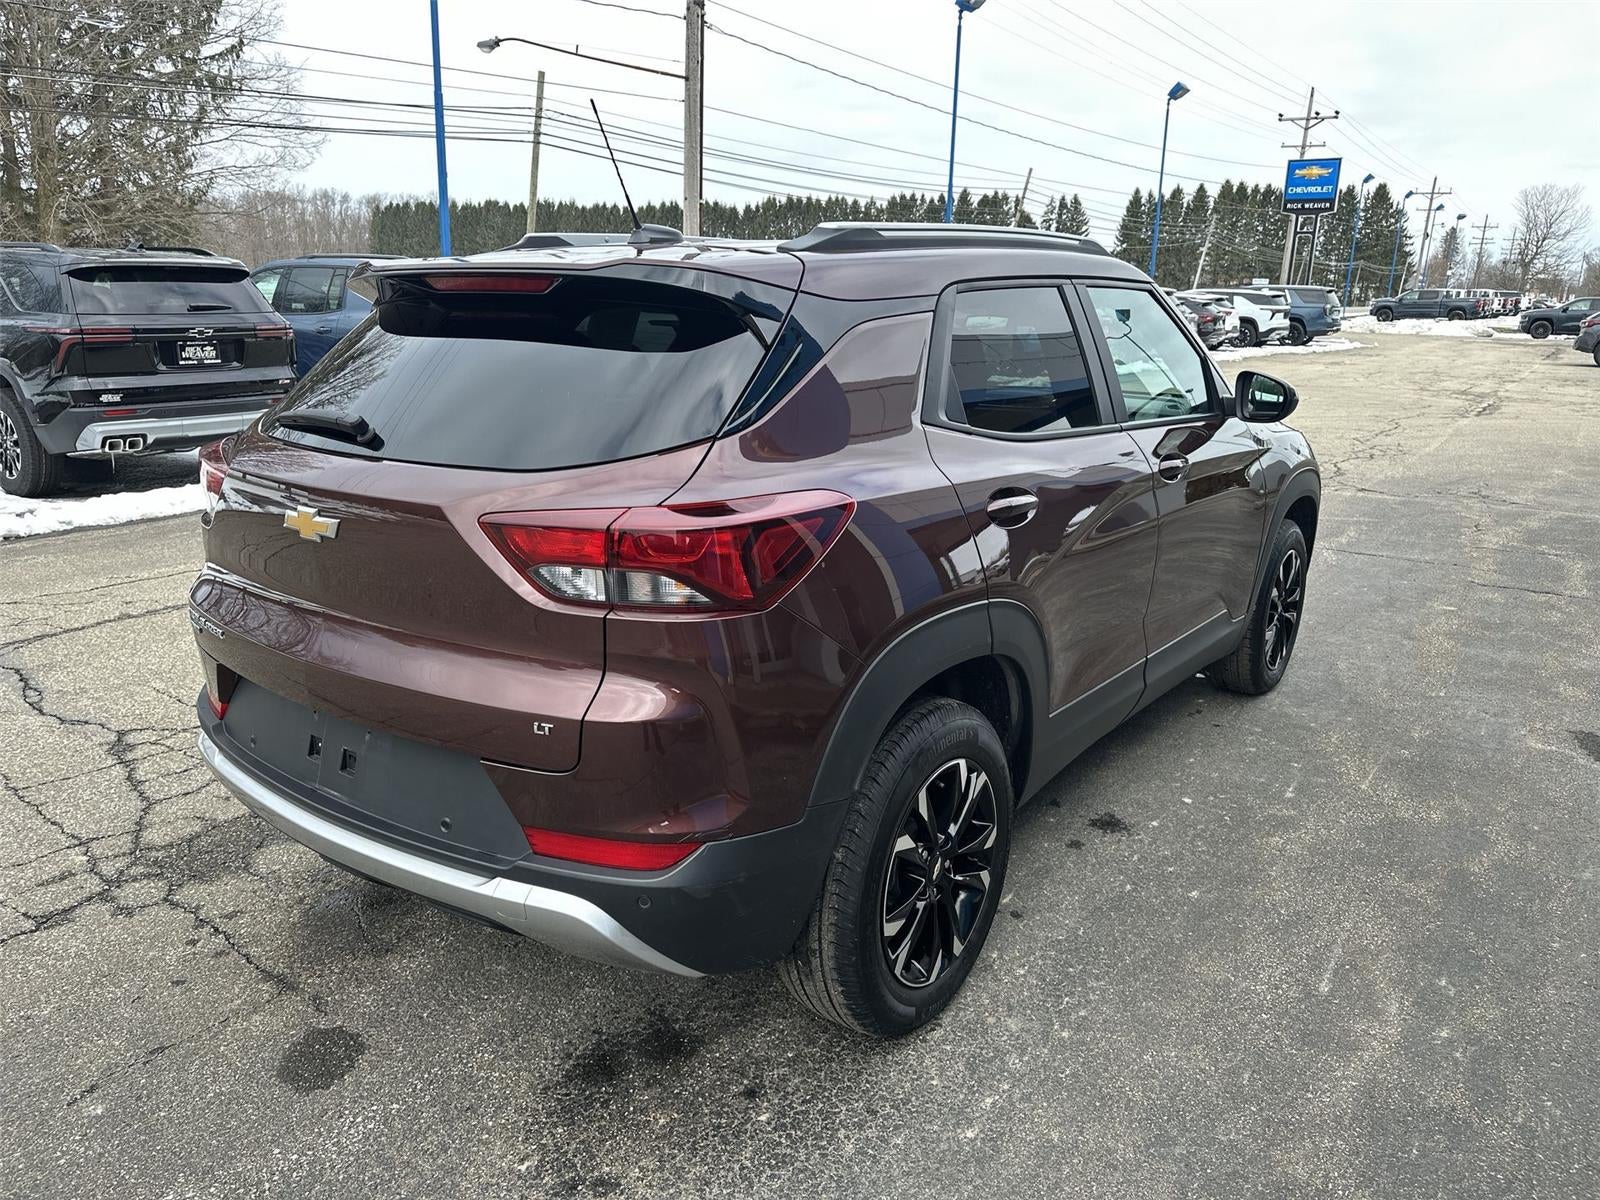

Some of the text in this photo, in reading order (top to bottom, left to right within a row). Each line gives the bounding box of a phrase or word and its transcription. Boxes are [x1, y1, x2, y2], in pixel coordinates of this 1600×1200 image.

[1288, 186, 1333, 194] CHEVROLET
[181, 350, 217, 359] WEAVER
[533, 721, 554, 736] LT
